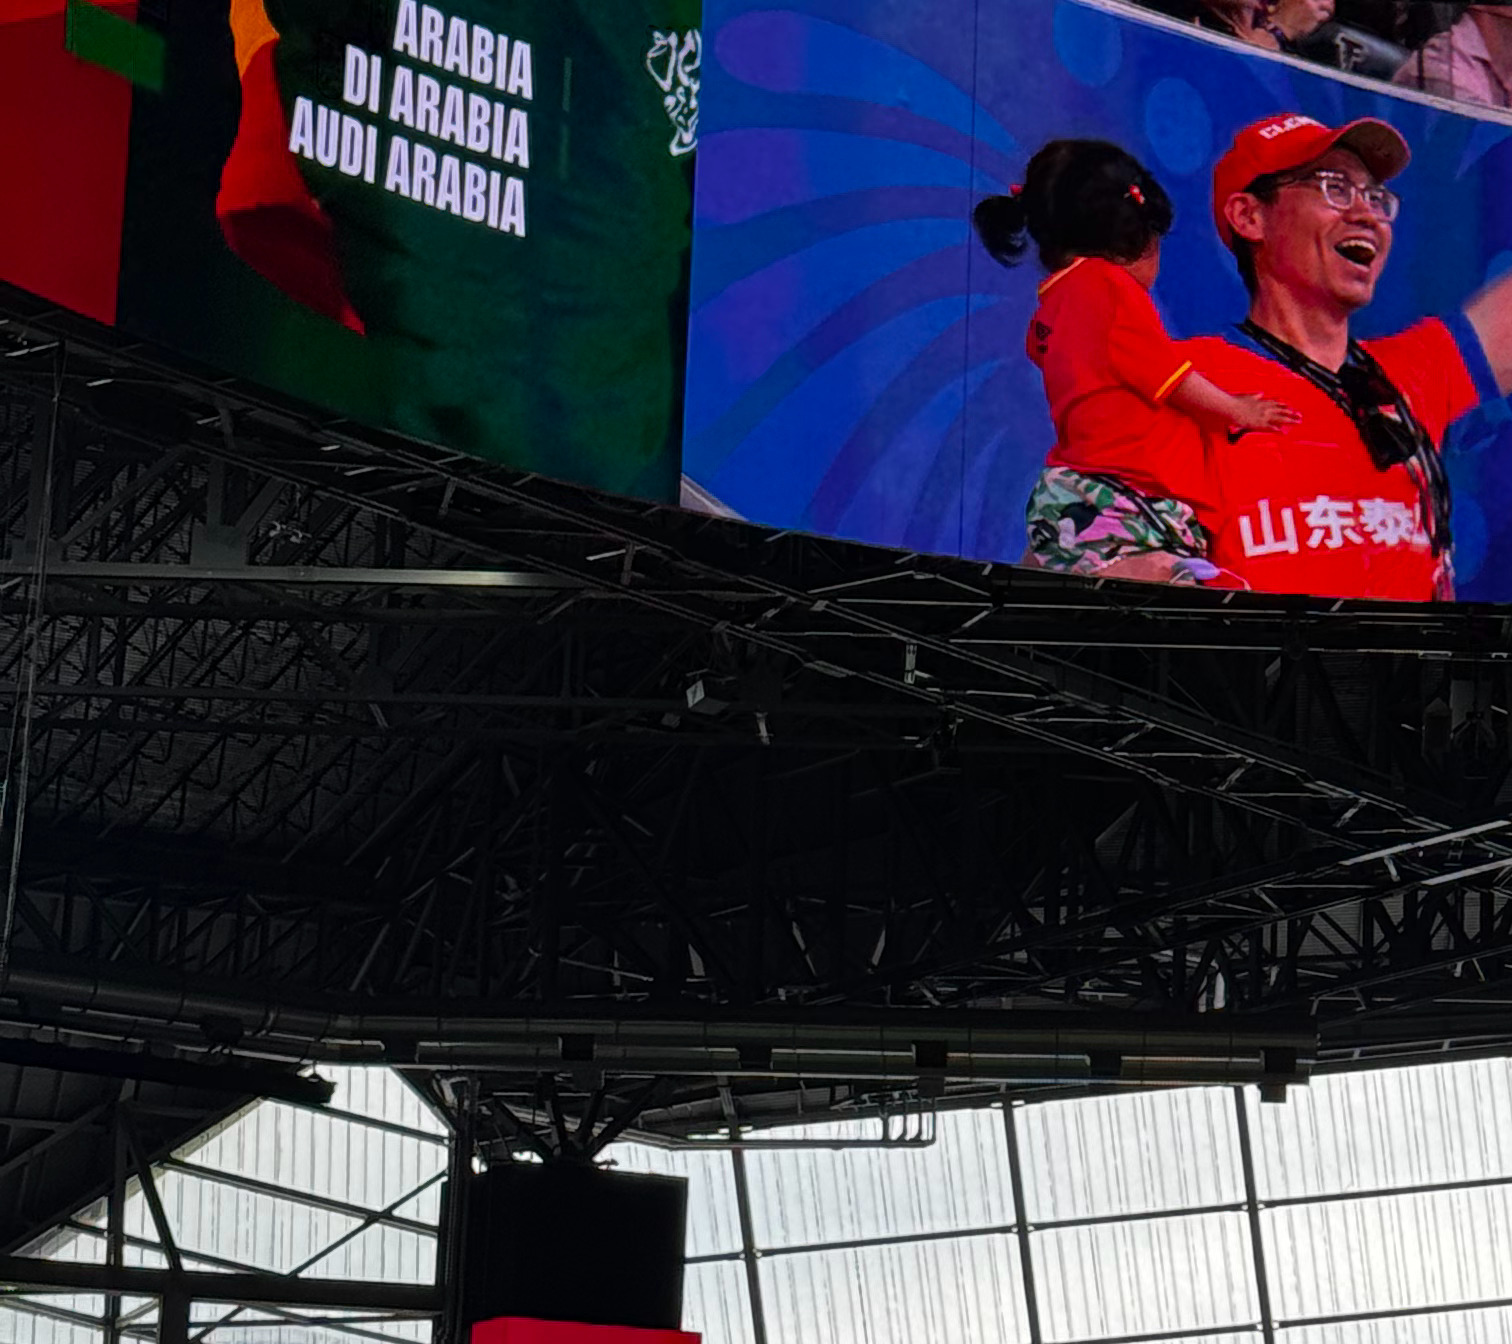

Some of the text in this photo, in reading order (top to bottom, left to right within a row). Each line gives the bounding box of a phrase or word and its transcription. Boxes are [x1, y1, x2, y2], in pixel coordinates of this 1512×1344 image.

[289, 96, 526, 238] AUDI ARABIA
[343, 44, 530, 169] DI ARABIA
